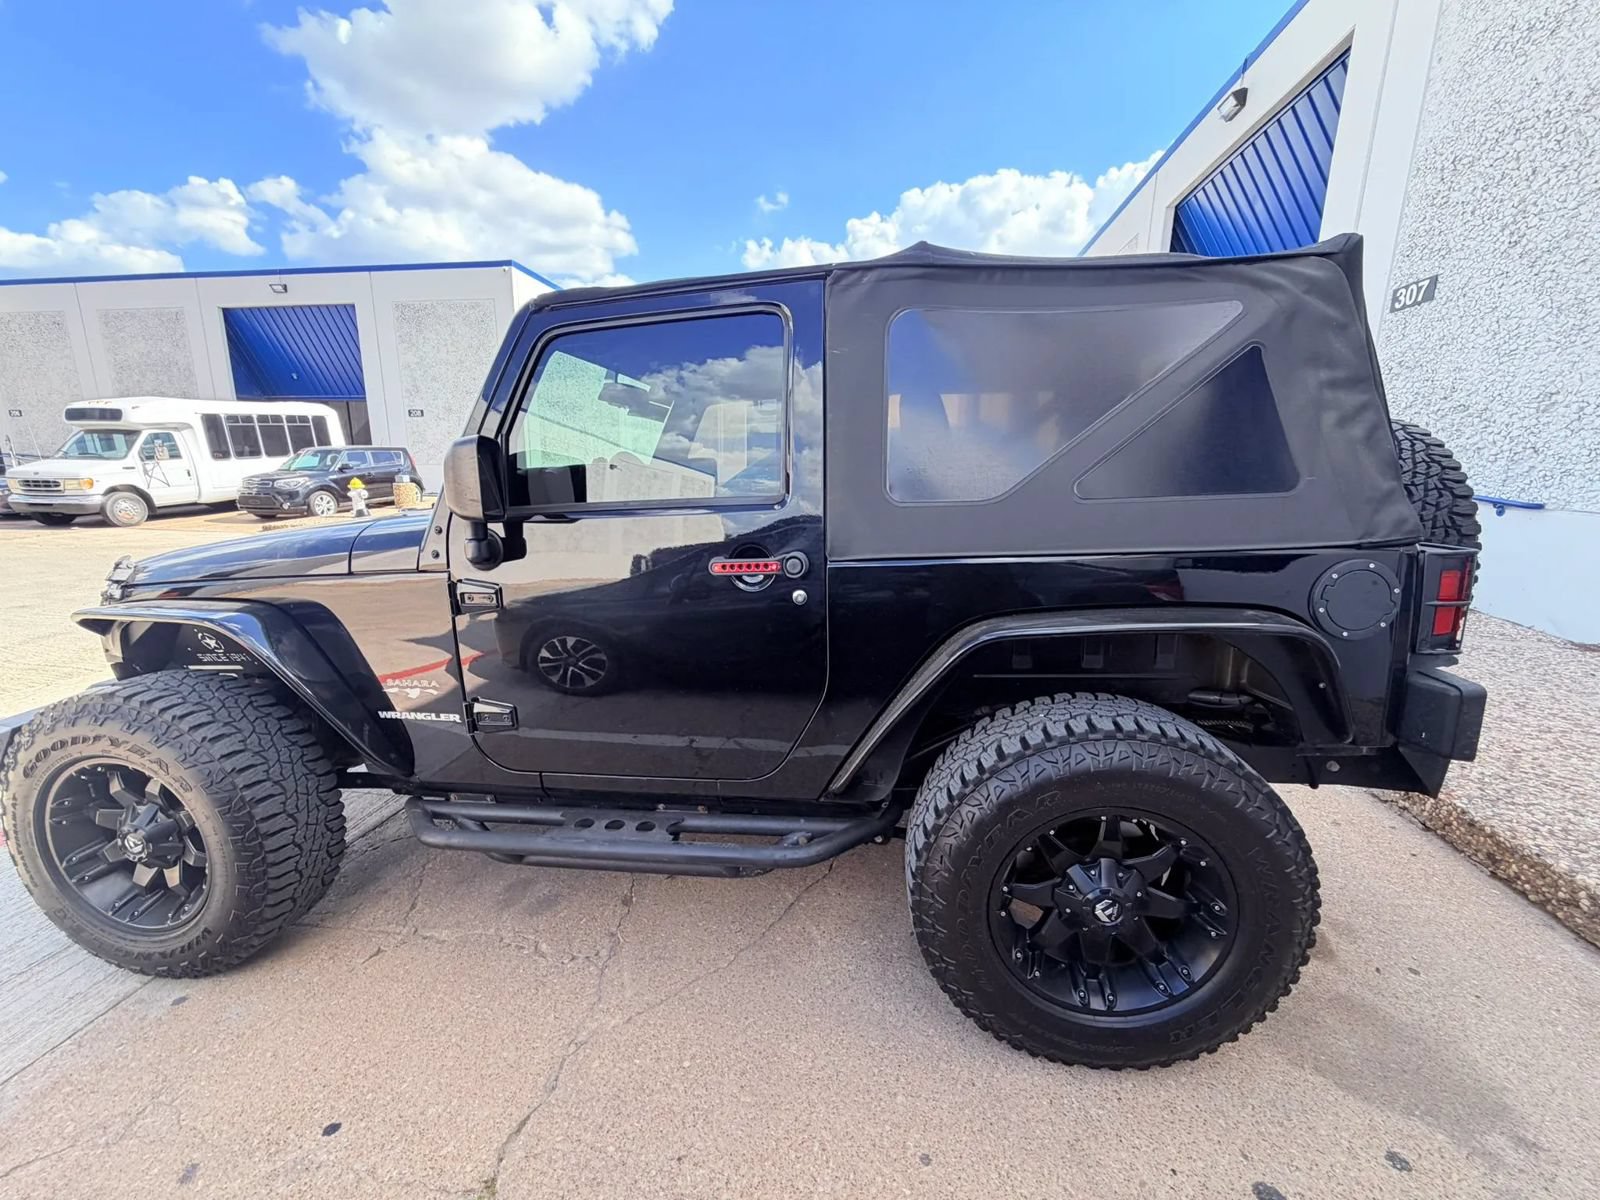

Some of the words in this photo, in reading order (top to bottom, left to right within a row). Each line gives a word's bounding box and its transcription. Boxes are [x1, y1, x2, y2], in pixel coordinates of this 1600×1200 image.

[1394, 279, 1431, 309] 307
[386, 678, 440, 688] SAHARA
[377, 710, 462, 723] WRANGLER
[23, 734, 193, 793] GOODYEAR
[1169, 846, 1282, 1046] WRANGLER
